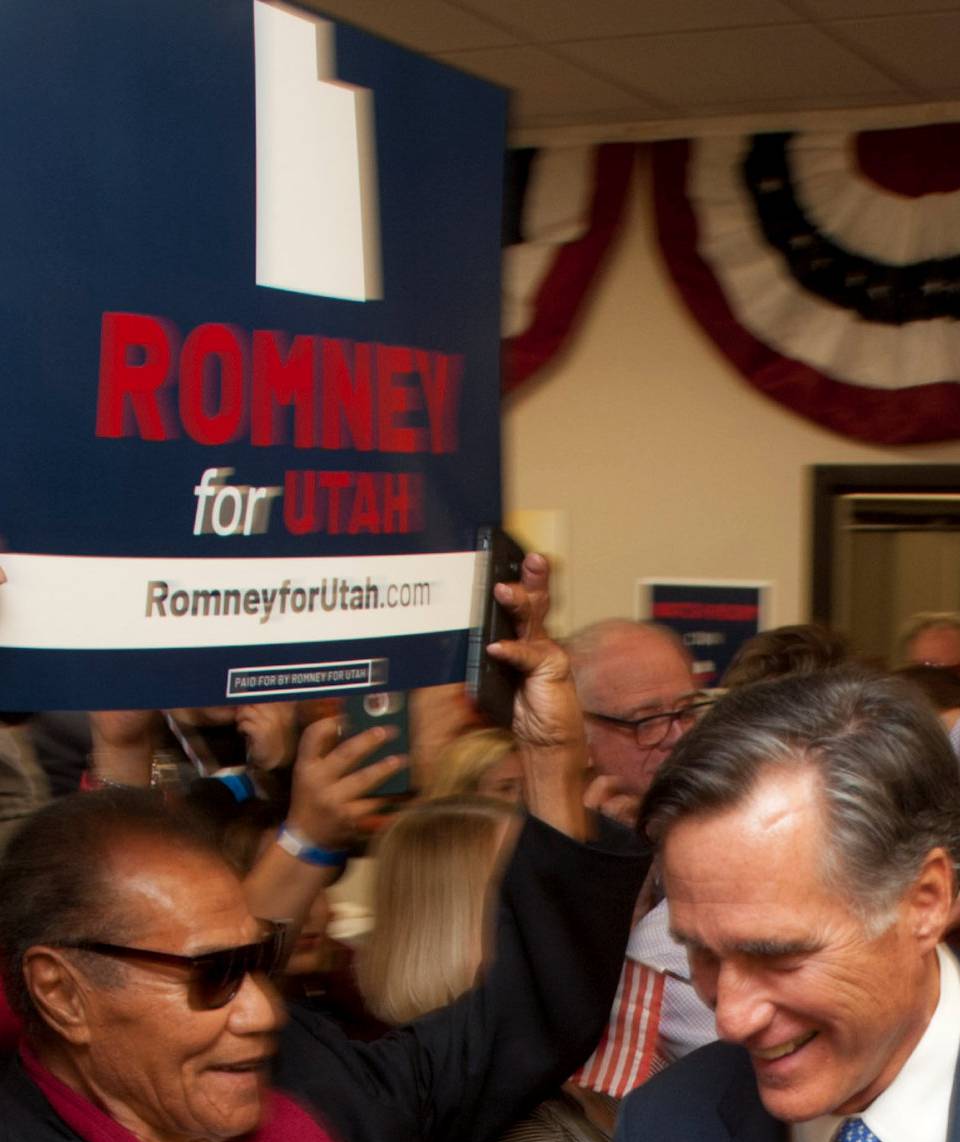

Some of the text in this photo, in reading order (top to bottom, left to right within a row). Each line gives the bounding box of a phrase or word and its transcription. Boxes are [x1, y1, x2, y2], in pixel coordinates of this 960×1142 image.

[95, 311, 462, 454] ROMNEY
[193, 467, 416, 536] for UTAH
[145, 577, 431, 624] RomneyforUtah.com
[234, 668, 367, 688] PAID FOR BY ROMNEY FOR UTAH
